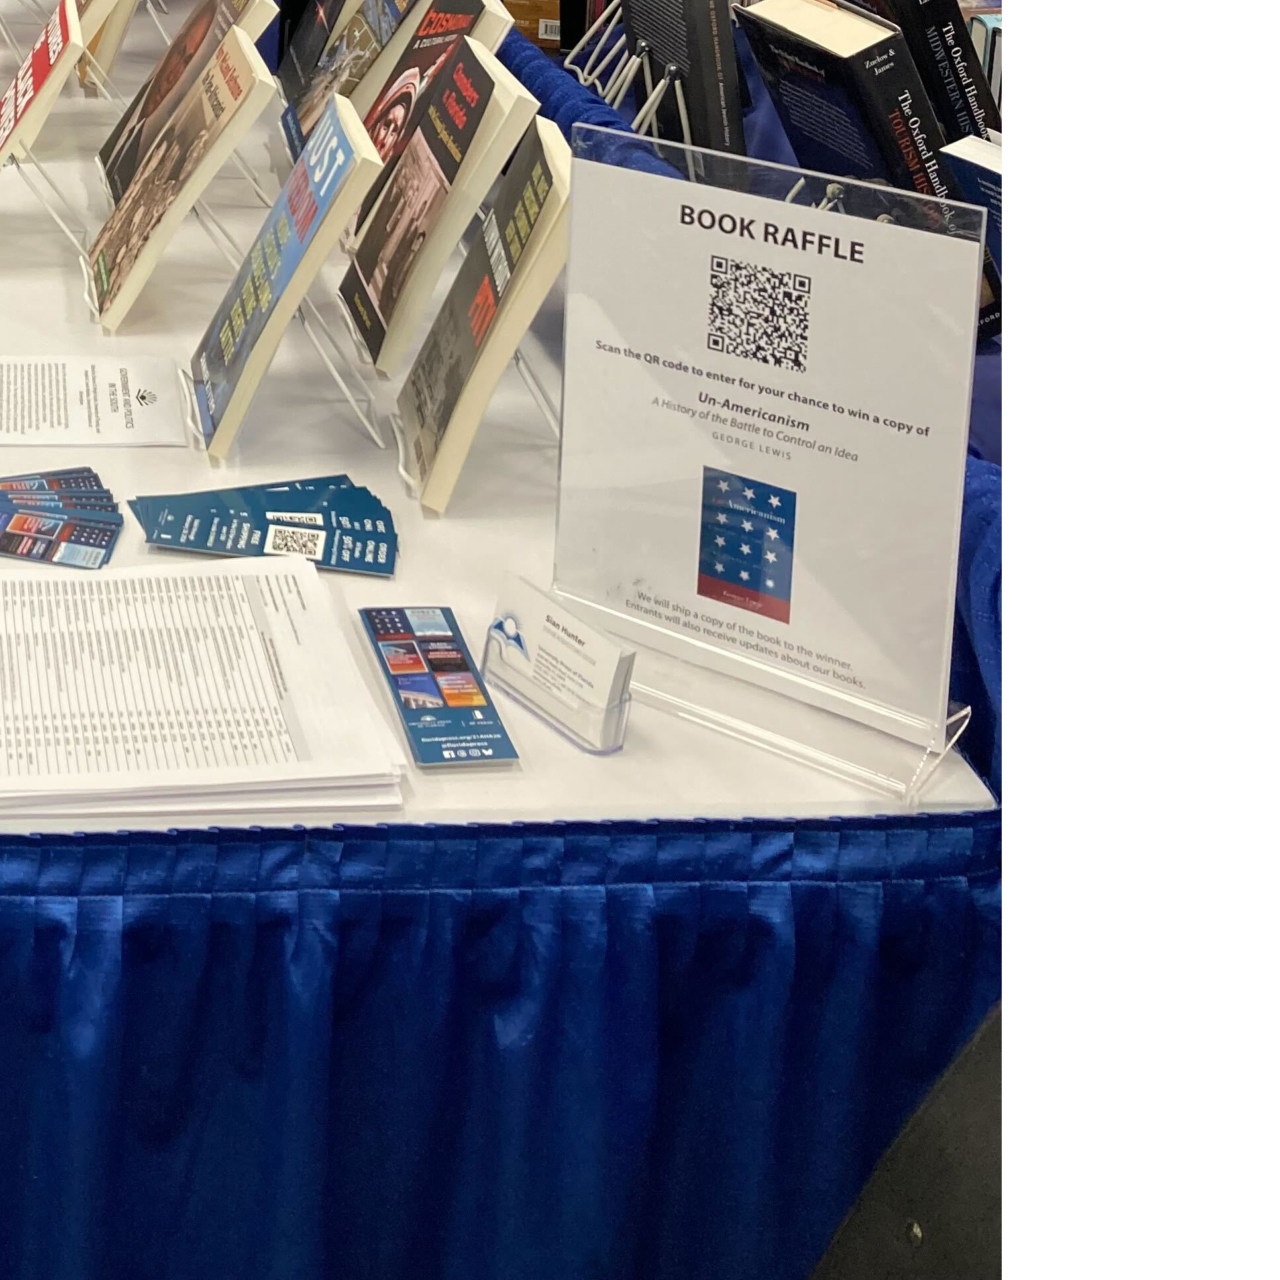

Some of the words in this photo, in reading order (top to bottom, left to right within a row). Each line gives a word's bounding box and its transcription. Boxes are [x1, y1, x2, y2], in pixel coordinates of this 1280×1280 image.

[709, 9, 718, 35] OXFORD
[865, 52, 888, 70] Zuelow
[888, 48, 896, 57] &
[874, 60, 894, 76] James
[925, 25, 965, 110] MIDWESTERN
[942, 22, 955, 46] The
[951, 45, 970, 87] Oxford
[964, 84, 991, 142] Handbook
[16, 54, 34, 114] BLACK
[718, 81, 727, 108] American
[308, 110, 345, 197] JUST
[722, 126, 730, 146] History
[888, 108, 922, 172] TOURISM
[897, 89, 912, 117] The
[908, 117, 933, 160] Oxford
[924, 156, 955, 224] Handbook
[287, 157, 318, 244] FREEDOM
[680, 204, 755, 239] BOOK
[763, 222, 865, 263] RAFFLE
[468, 273, 496, 348] PITY
[595, 340, 621, 355] Scan
[623, 347, 641, 361] the
[644, 352, 660, 365] QR
[662, 359, 689, 373] code
[691, 366, 703, 377] to
[706, 370, 735, 386] enter
[738, 377, 755, 391] for
[758, 384, 785, 399] your
[788, 392, 829, 410] chance
[832, 403, 844, 414] to
[847, 408, 870, 421] win
[873, 415, 880, 424] a
[883, 418, 913, 435] copy
[916, 426, 930, 438] of
[698, 392, 810, 432] Un-Americanism
[123, 408, 134, 428] POLITICS
[652, 397, 659, 406] A
[661, 399, 698, 419] History
[699, 408, 710, 421] of
[711, 413, 728, 426] the
[730, 418, 760, 435] Battle
[762, 426, 774, 439] to
[776, 430, 816, 450] Control
[817, 442, 832, 454] an
[834, 446, 859, 462] Idea
[712, 431, 754, 453] GEORGE
[759, 444, 792, 460] LEWIS
[237, 523, 250, 549] SHIPPING
[728, 500, 785, 525] Americanism
[365, 540, 375, 563] ONLINE
[378, 543, 387, 564] ORDER
[545, 614, 560, 630] Sian
[561, 624, 586, 647] Hunter
[625, 599, 662, 619] Entrants
[664, 614, 680, 625] will
[682, 620, 700, 632] also
[703, 627, 737, 644] receive
[739, 639, 778, 659] updates
[781, 654, 810, 670] about
[813, 664, 830, 676] our
[833, 670, 865, 689] books.
[637, 591, 651, 603] We
[654, 596, 670, 609] will
[672, 604, 691, 617] ship
[701, 614, 724, 628] copy
[726, 622, 736, 630] of
[738, 624, 754, 637] the
[757, 630, 782, 646] book
[784, 641, 794, 651] to
[797, 645, 813, 657] the
[816, 652, 853, 671] winner.
